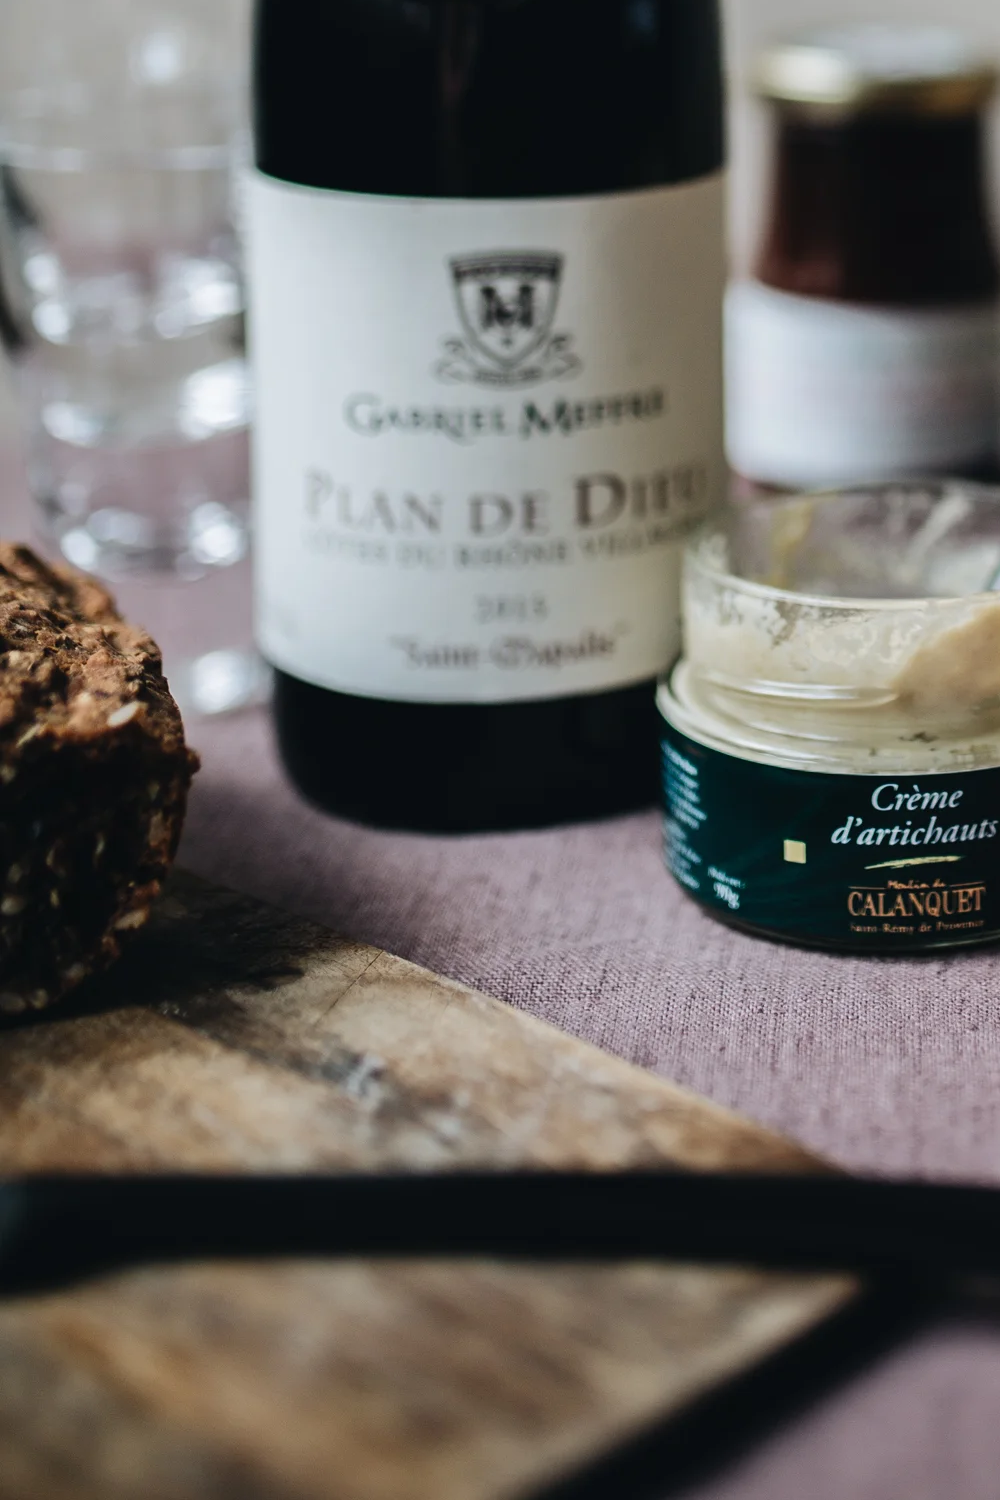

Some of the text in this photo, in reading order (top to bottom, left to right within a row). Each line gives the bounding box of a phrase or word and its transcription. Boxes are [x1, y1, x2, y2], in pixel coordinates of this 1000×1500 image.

[341, 392, 510, 446] GABRIEL
[302, 465, 445, 536] PLAN
[467, 490, 552, 537] DE
[871, 783, 963, 811] Crème
[848, 886, 986, 917] CALANQUET
